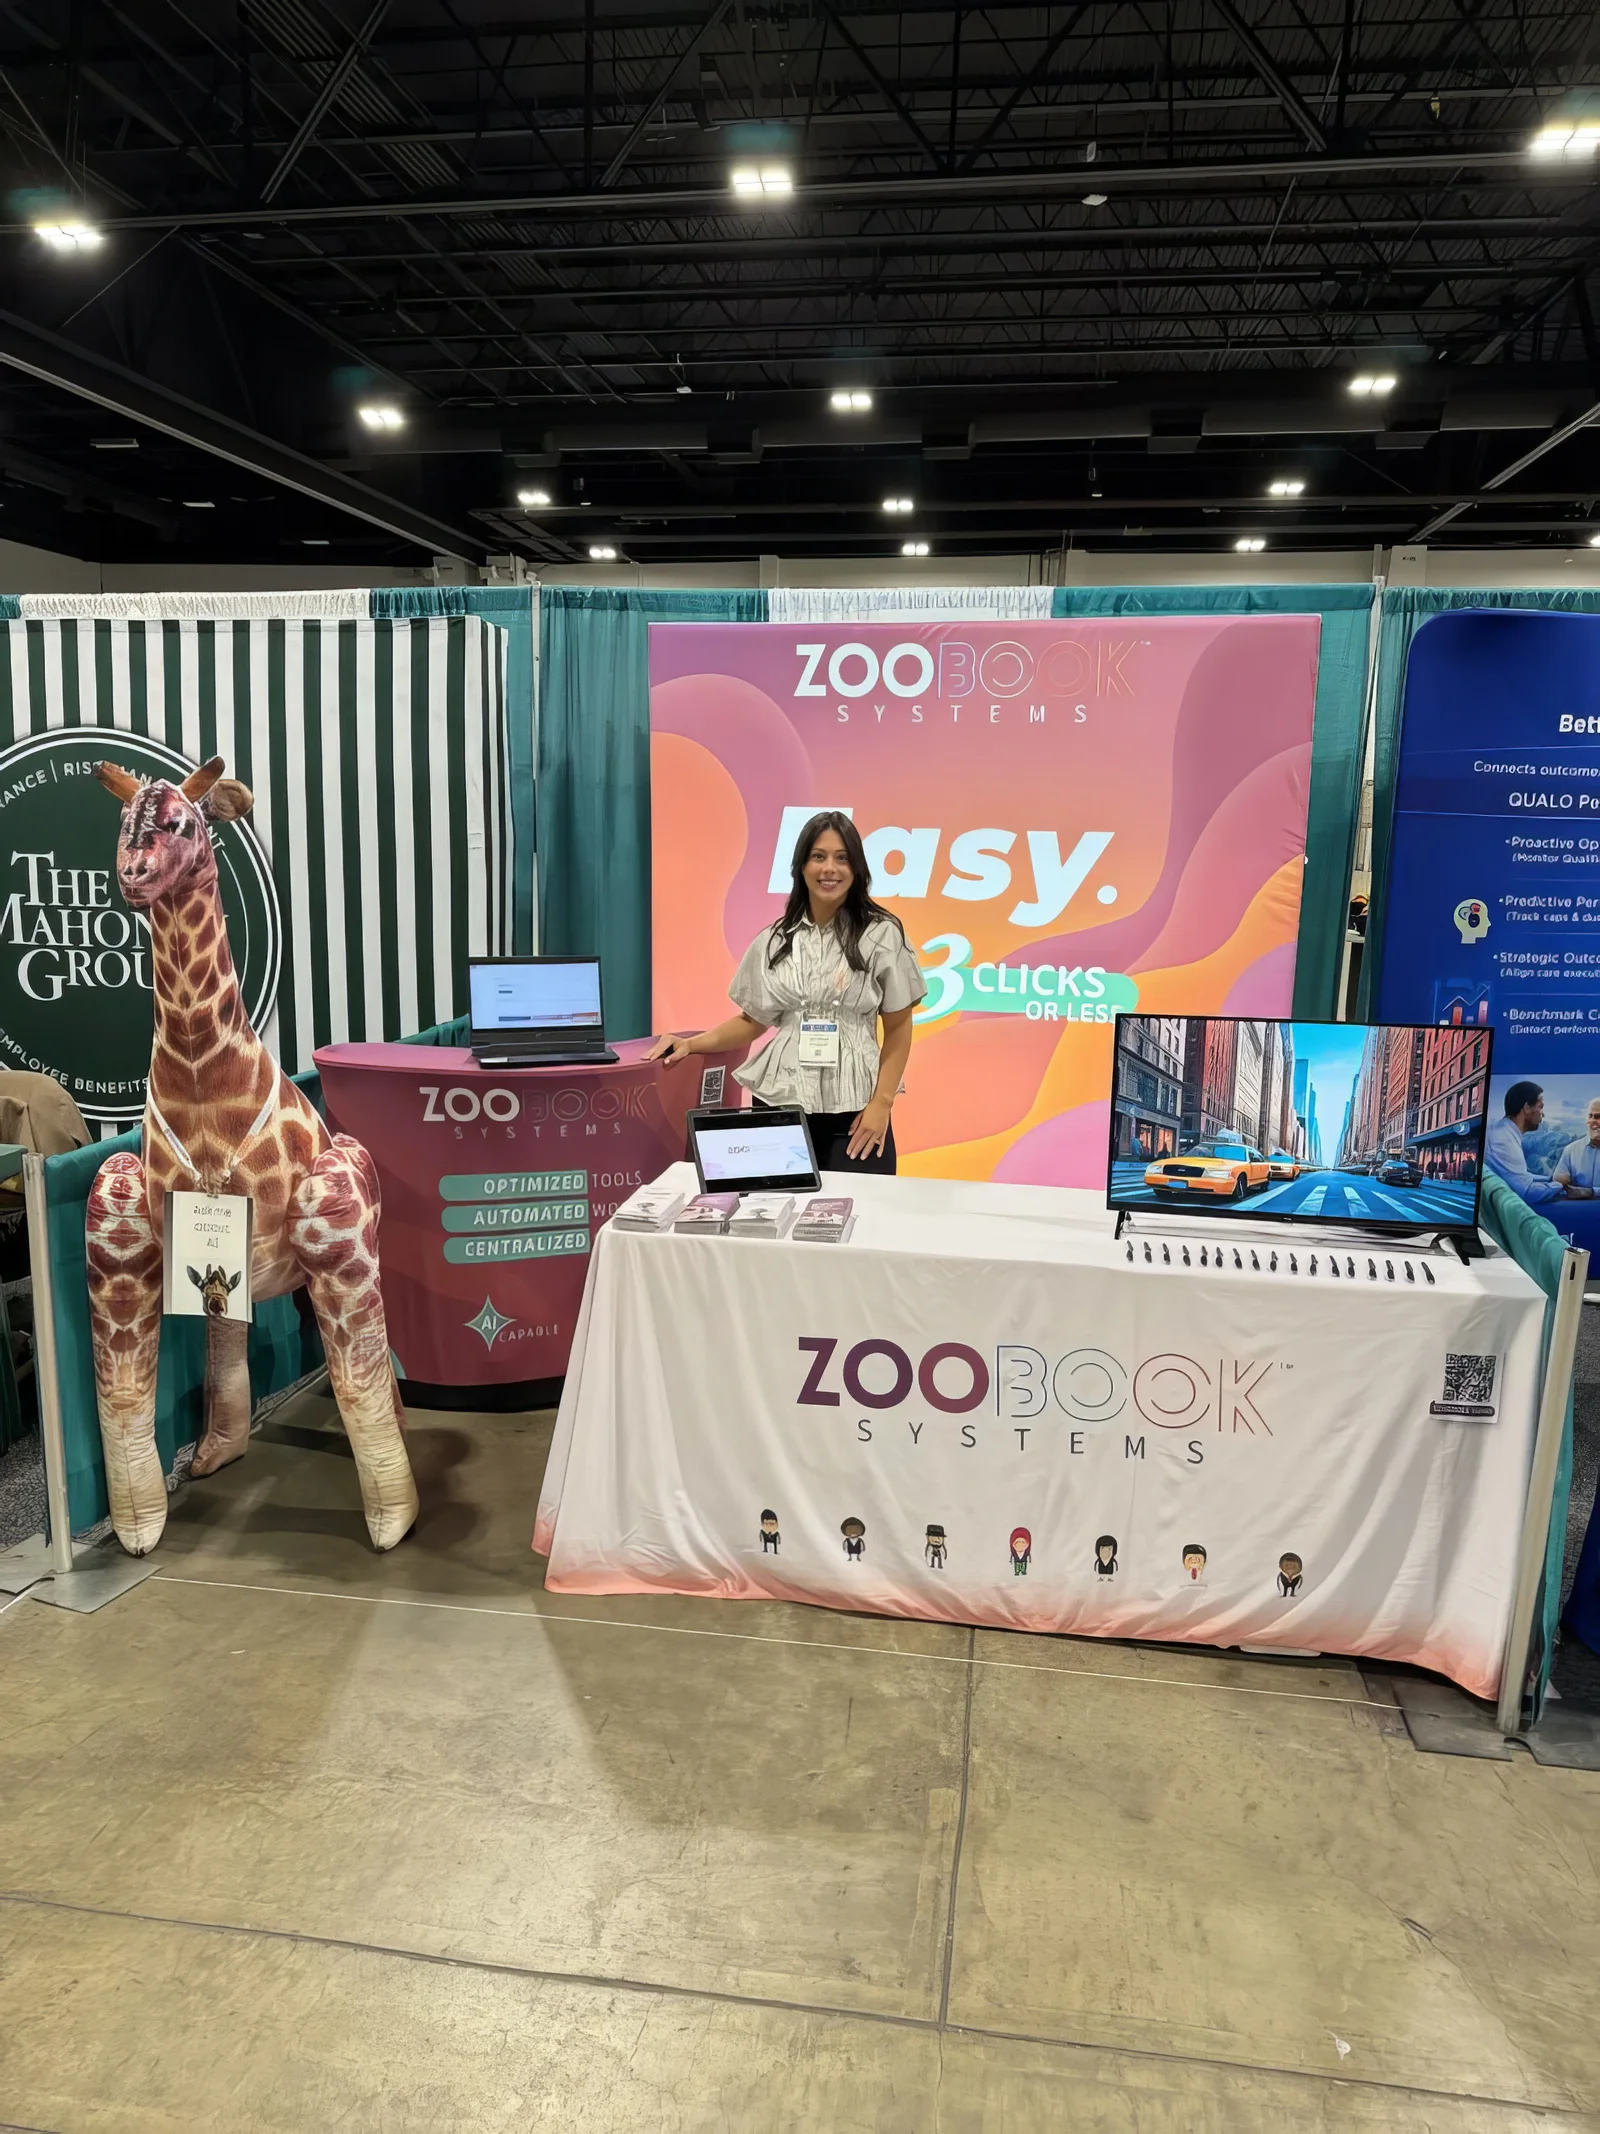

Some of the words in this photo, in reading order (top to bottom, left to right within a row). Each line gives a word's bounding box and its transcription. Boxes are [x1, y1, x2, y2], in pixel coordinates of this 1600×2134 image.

[793, 640, 1137, 698] ZOOBOOK
[837, 704, 1087, 723] SYSTEMS
[1540, 766, 1600, 777] outcome
[1508, 792, 1573, 808] QUALO
[1578, 838, 1600, 851] Op
[10, 850, 111, 908] THE
[911, 933, 973, 1026] 3
[972, 961, 1107, 998] CLICKS
[1025, 1000, 1058, 1022] OR
[454, 1121, 621, 1140] SYSTEMS
[484, 1174, 585, 1195] OPTIMIZED
[592, 1170, 643, 1188] TOOLS
[473, 1203, 585, 1226] AUTOMATED
[465, 1232, 587, 1257] CENTRALIZED
[481, 1315, 497, 1330] AI
[796, 1336, 1274, 1436] ZOOBOOK
[857, 1418, 1205, 1465] SYSTEMS
